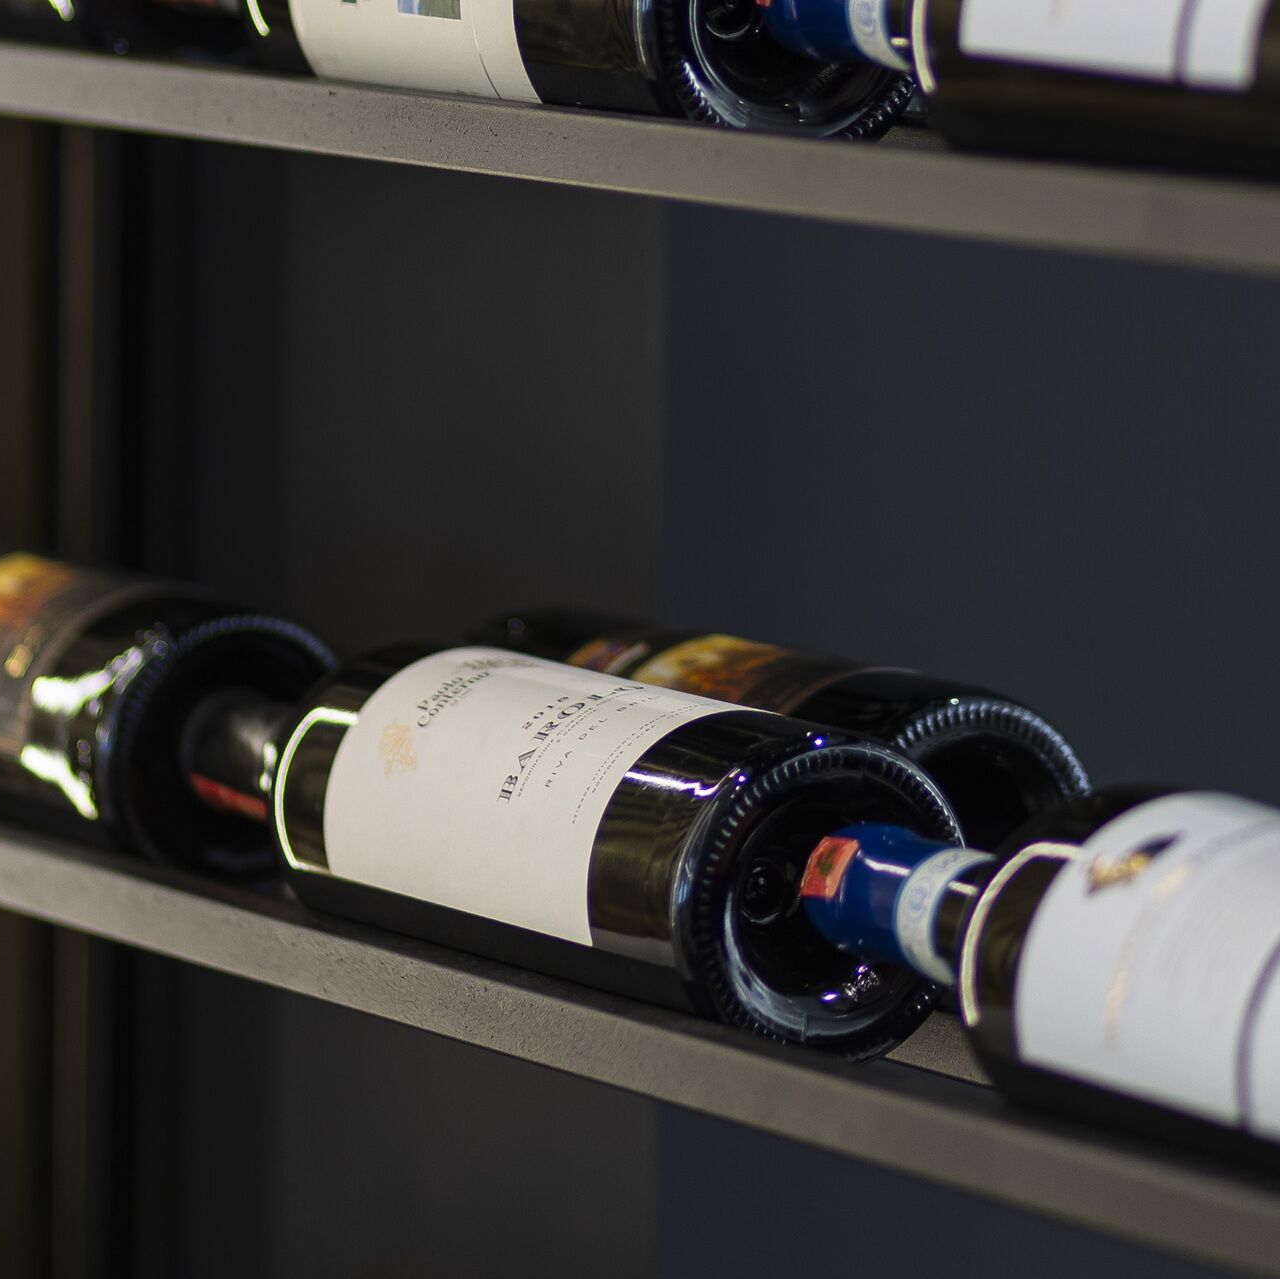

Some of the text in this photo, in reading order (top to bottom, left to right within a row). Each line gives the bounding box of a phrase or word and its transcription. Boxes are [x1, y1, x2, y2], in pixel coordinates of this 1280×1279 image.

[417, 677, 464, 711] Paolo
[417, 671, 489, 728] Conterno
[497, 684, 645, 805] BAROLO
[544, 750, 573, 788] RIVA
[578, 718, 609, 741] DEL
